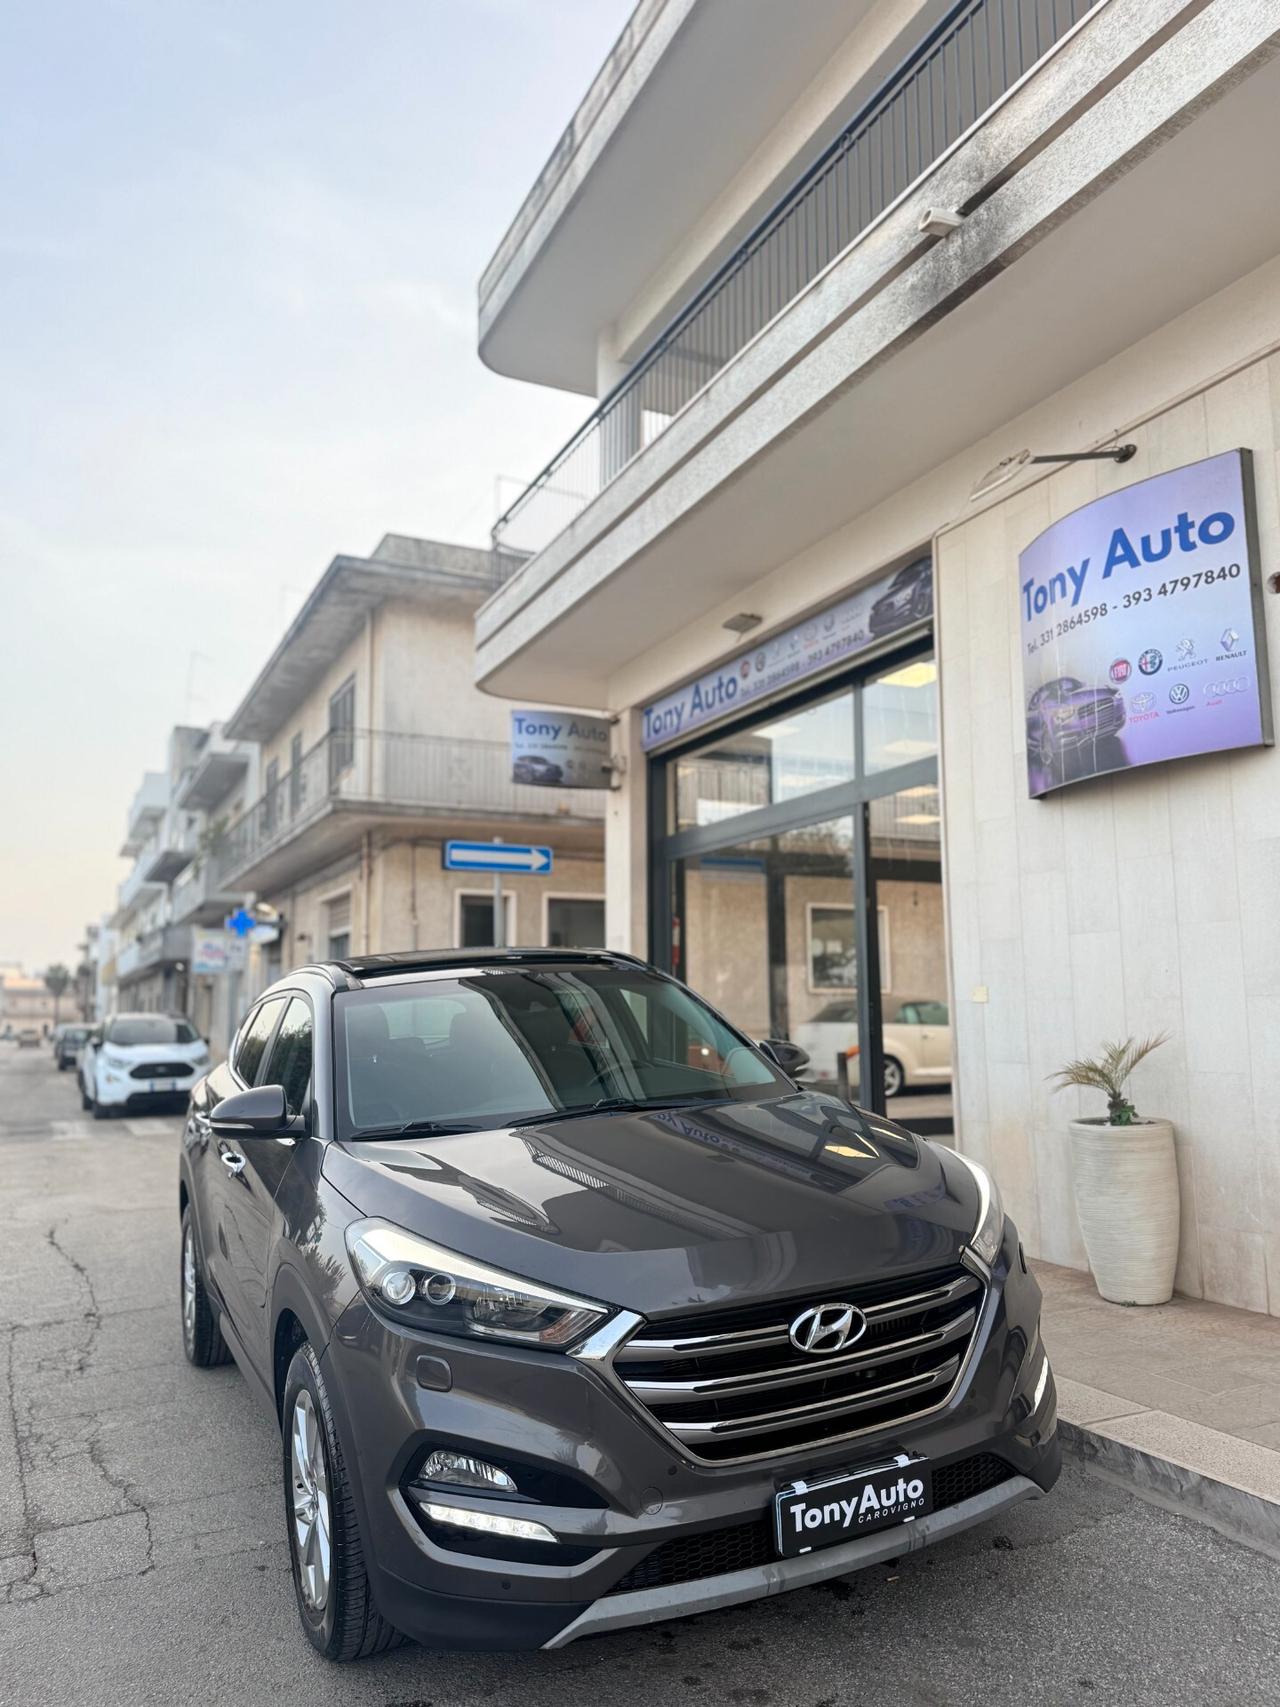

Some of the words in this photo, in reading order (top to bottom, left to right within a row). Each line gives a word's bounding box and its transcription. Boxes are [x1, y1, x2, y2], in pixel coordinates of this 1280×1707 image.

[1023, 557, 1091, 622] Tony
[1102, 512, 1235, 579] Auto
[1040, 629, 1054, 647] 331
[1056, 603, 1108, 637] 2864598
[1123, 587, 1152, 609] 393
[1157, 563, 1241, 597] 4797840
[1167, 659, 1208, 672] PEUGEOT
[1216, 650, 1247, 662] RENAULT
[644, 701, 685, 738] Tony
[690, 676, 737, 718] Auto
[1128, 711, 1159, 724] TOYOTA
[514, 718, 562, 740] Tony
[568, 720, 607, 742] Auto
[790, 1477, 924, 1533] TonyAuto
[858, 1498, 925, 1524] CAROVIGNO
